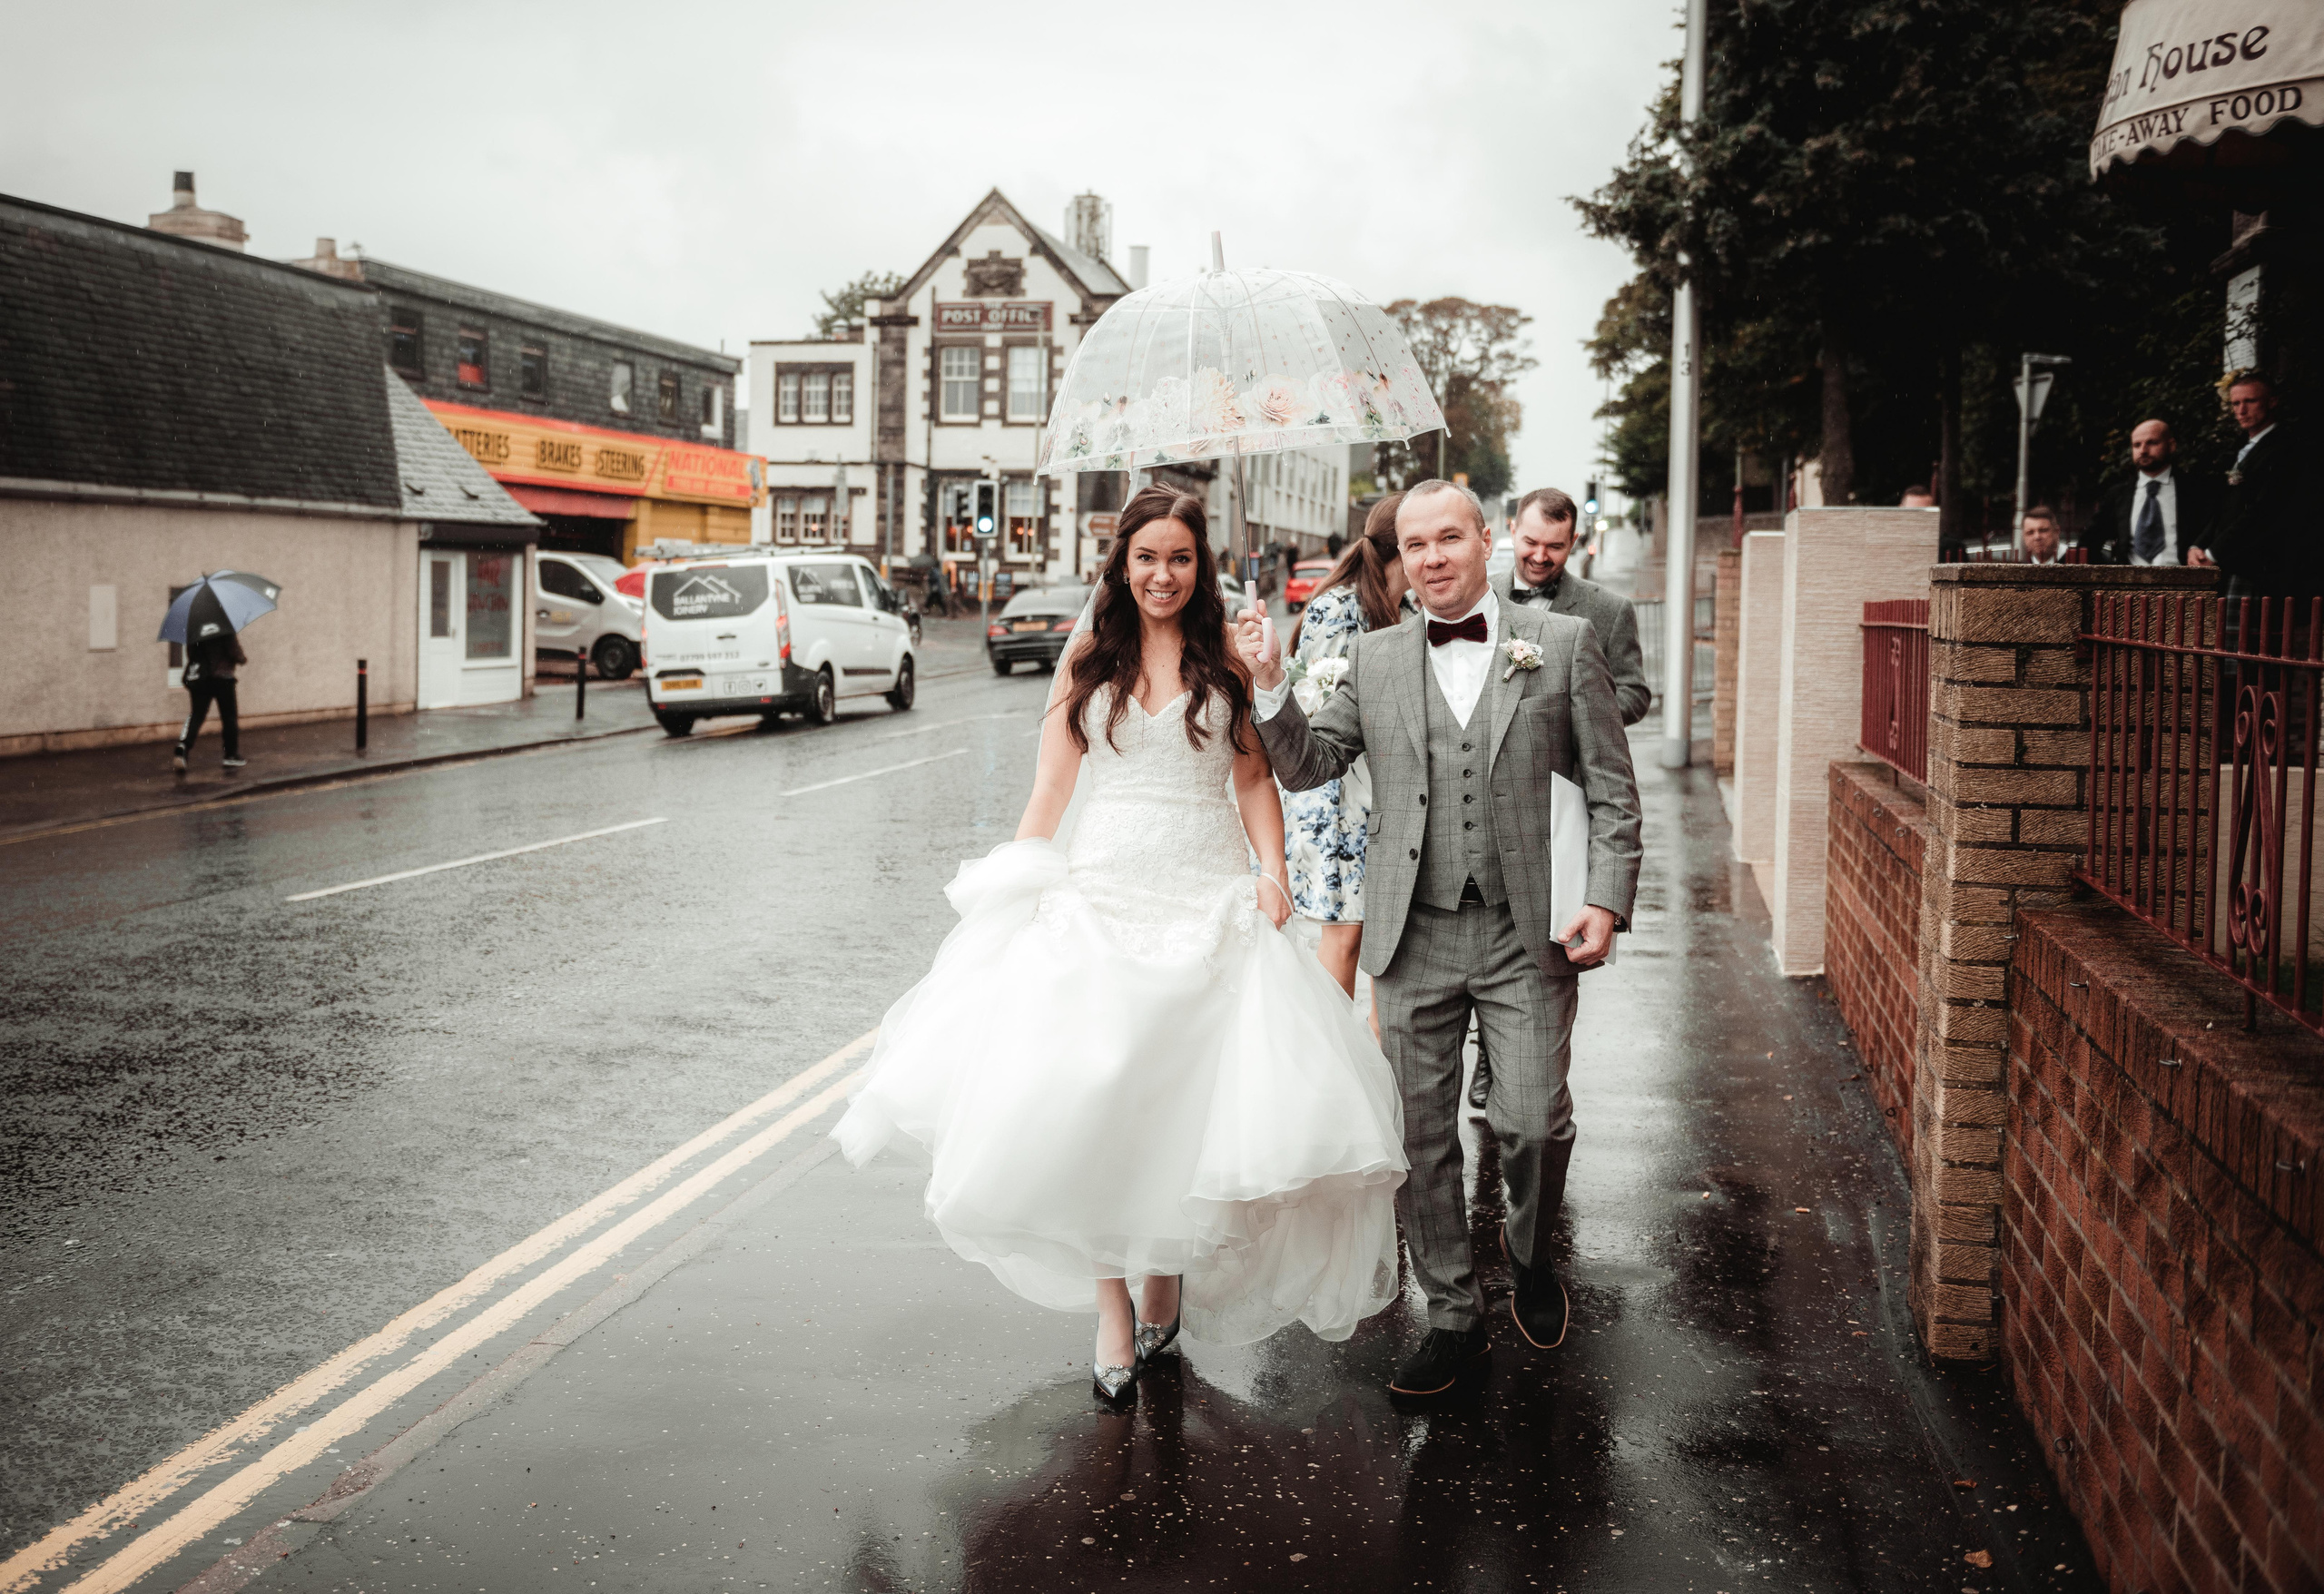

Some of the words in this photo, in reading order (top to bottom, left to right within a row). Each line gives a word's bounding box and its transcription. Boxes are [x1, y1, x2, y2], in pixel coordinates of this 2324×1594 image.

[2210, 85, 2302, 125] FOOD
[941, 309, 980, 324] POST
[988, 309, 1042, 324] OFFIC
[540, 439, 582, 467] BRAKES
[599, 448, 645, 477] STEERING
[667, 449, 745, 480] NATIONAL
